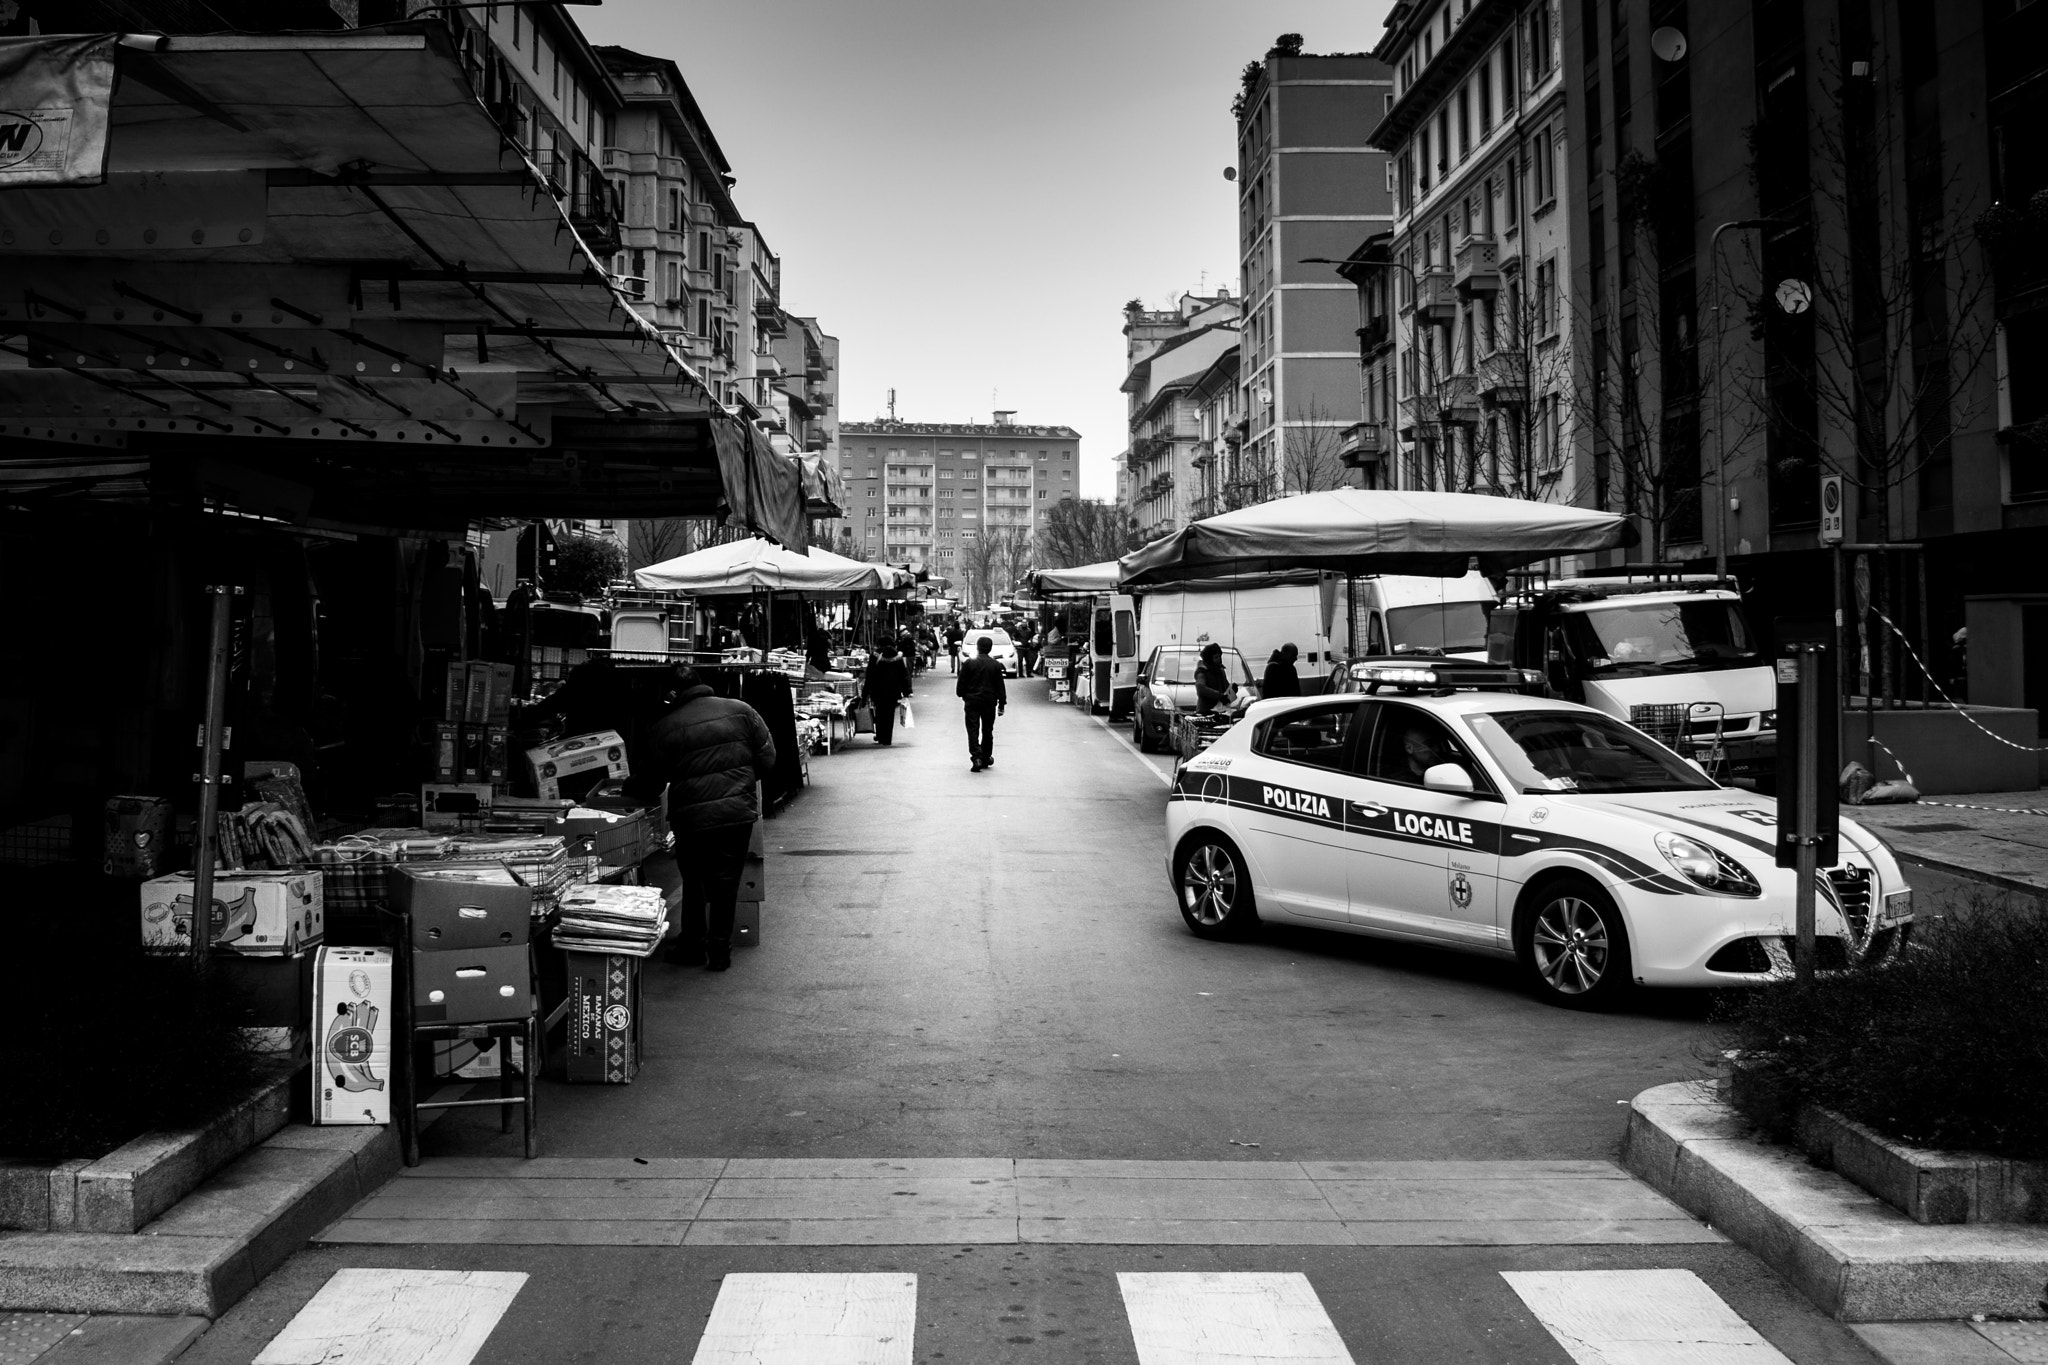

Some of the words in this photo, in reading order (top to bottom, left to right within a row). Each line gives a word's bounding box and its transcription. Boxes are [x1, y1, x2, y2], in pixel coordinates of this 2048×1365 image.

[1262, 785, 1331, 818] POLIZIA
[1393, 811, 1474, 844] LOCALE
[1451, 861, 1471, 871] Milano
[582, 994, 591, 1039] MEXICO
[595, 994, 603, 1040] BANANAS
[350, 1034, 360, 1058] SCB
